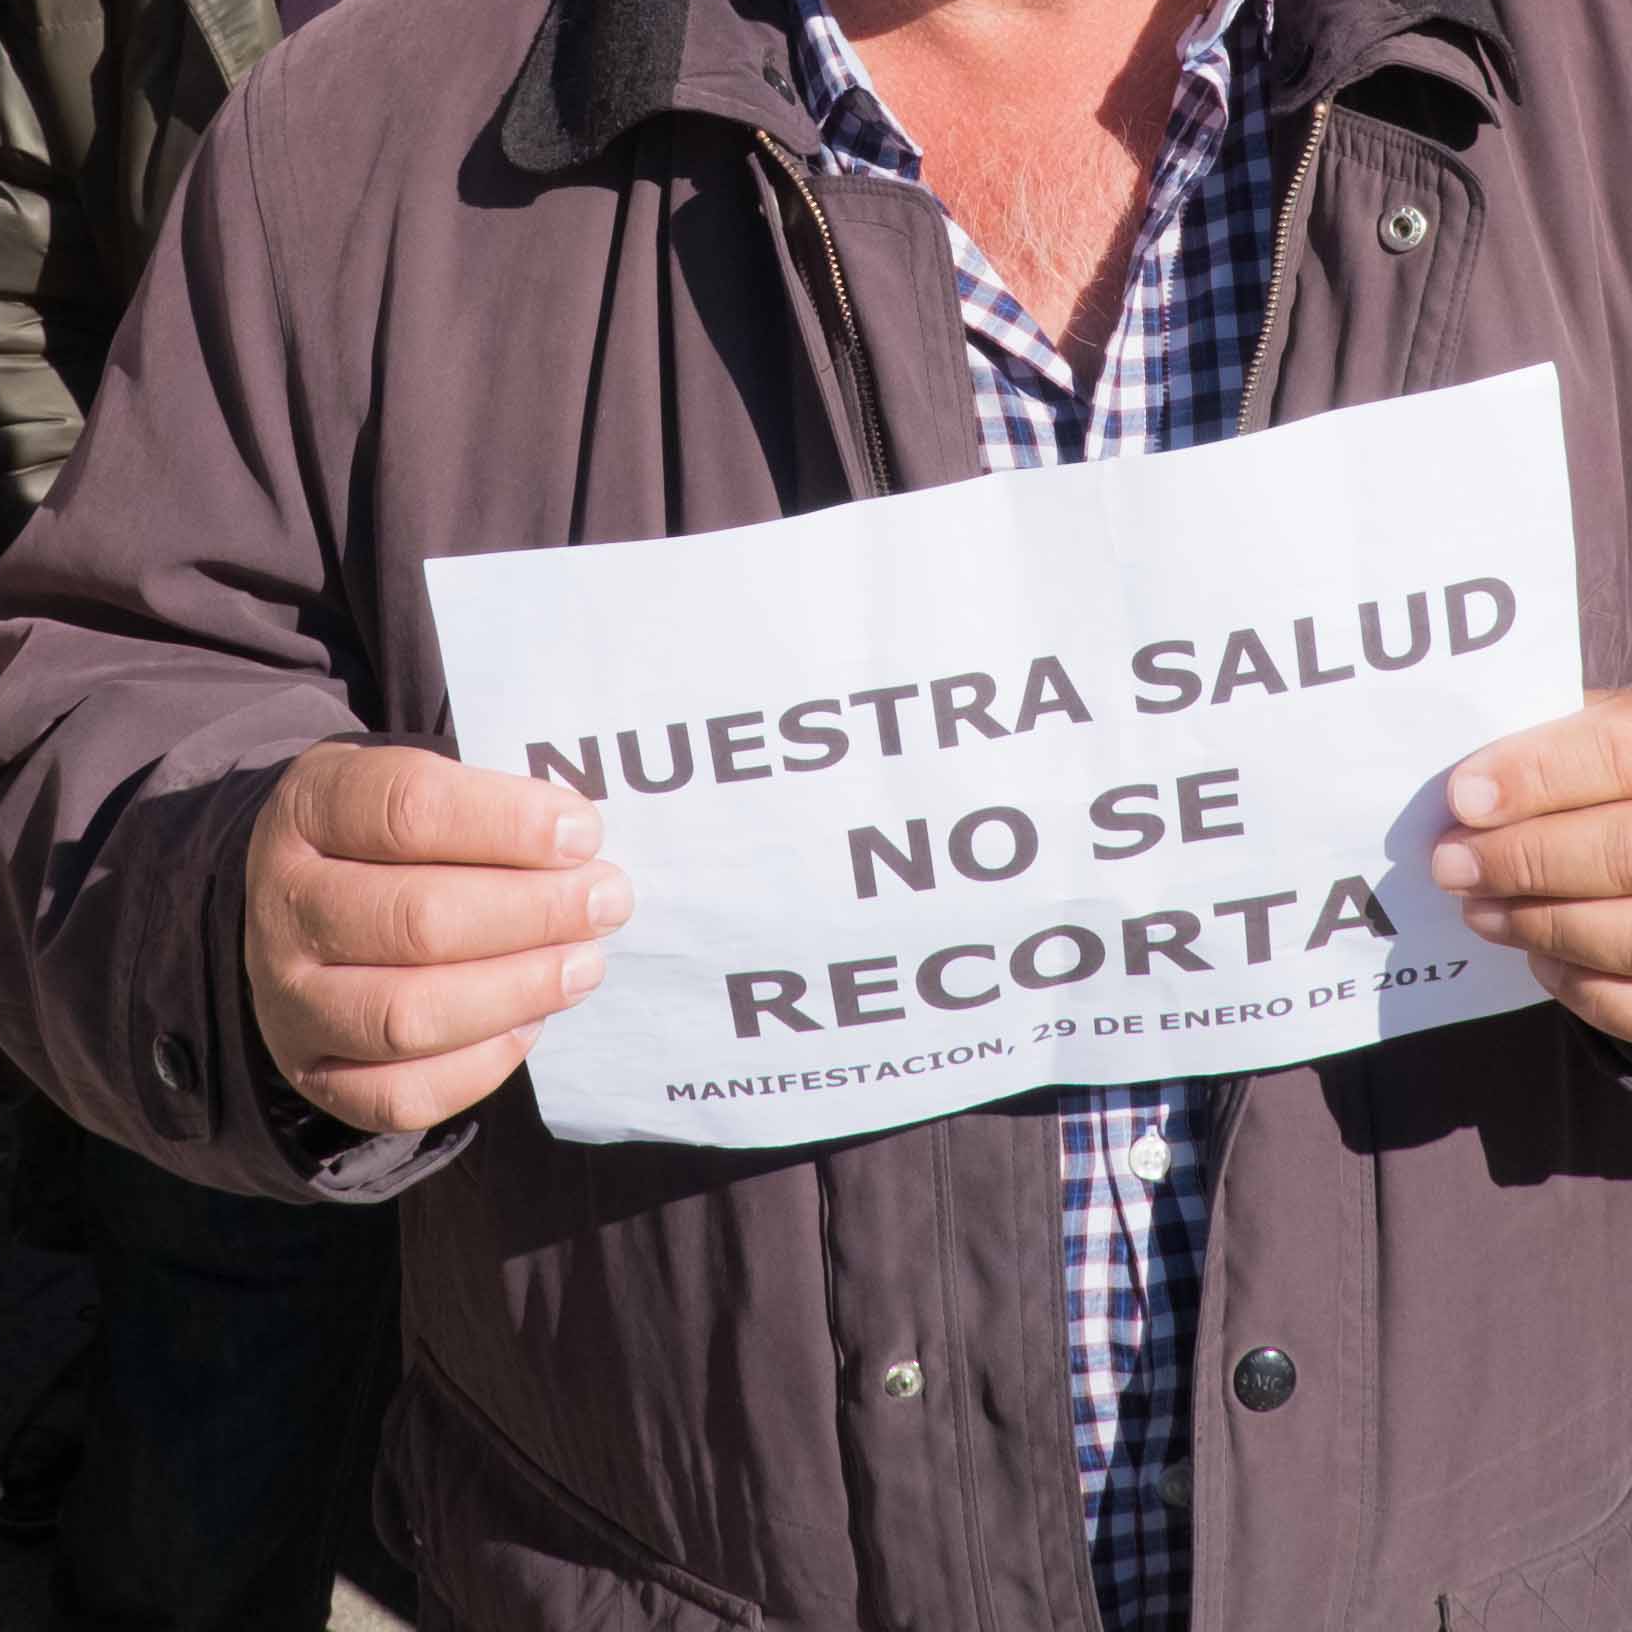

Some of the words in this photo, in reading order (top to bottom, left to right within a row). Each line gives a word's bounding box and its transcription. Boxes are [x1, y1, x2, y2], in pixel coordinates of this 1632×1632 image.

[524, 655, 1093, 802] NUESTRA
[1131, 577, 1516, 715] SALUD
[847, 806, 1039, 900] NO
[1089, 767, 1245, 861] SE
[666, 1038, 1015, 1102] MANIFESTACION,
[1031, 1019, 1077, 1043] 29
[1093, 1015, 1144, 1036] DE
[1159, 997, 1293, 1031] ENERO
[1308, 979, 1355, 1009] DE
[1373, 959, 1469, 992] 2017
[725, 874, 1399, 1039] RECORTA
